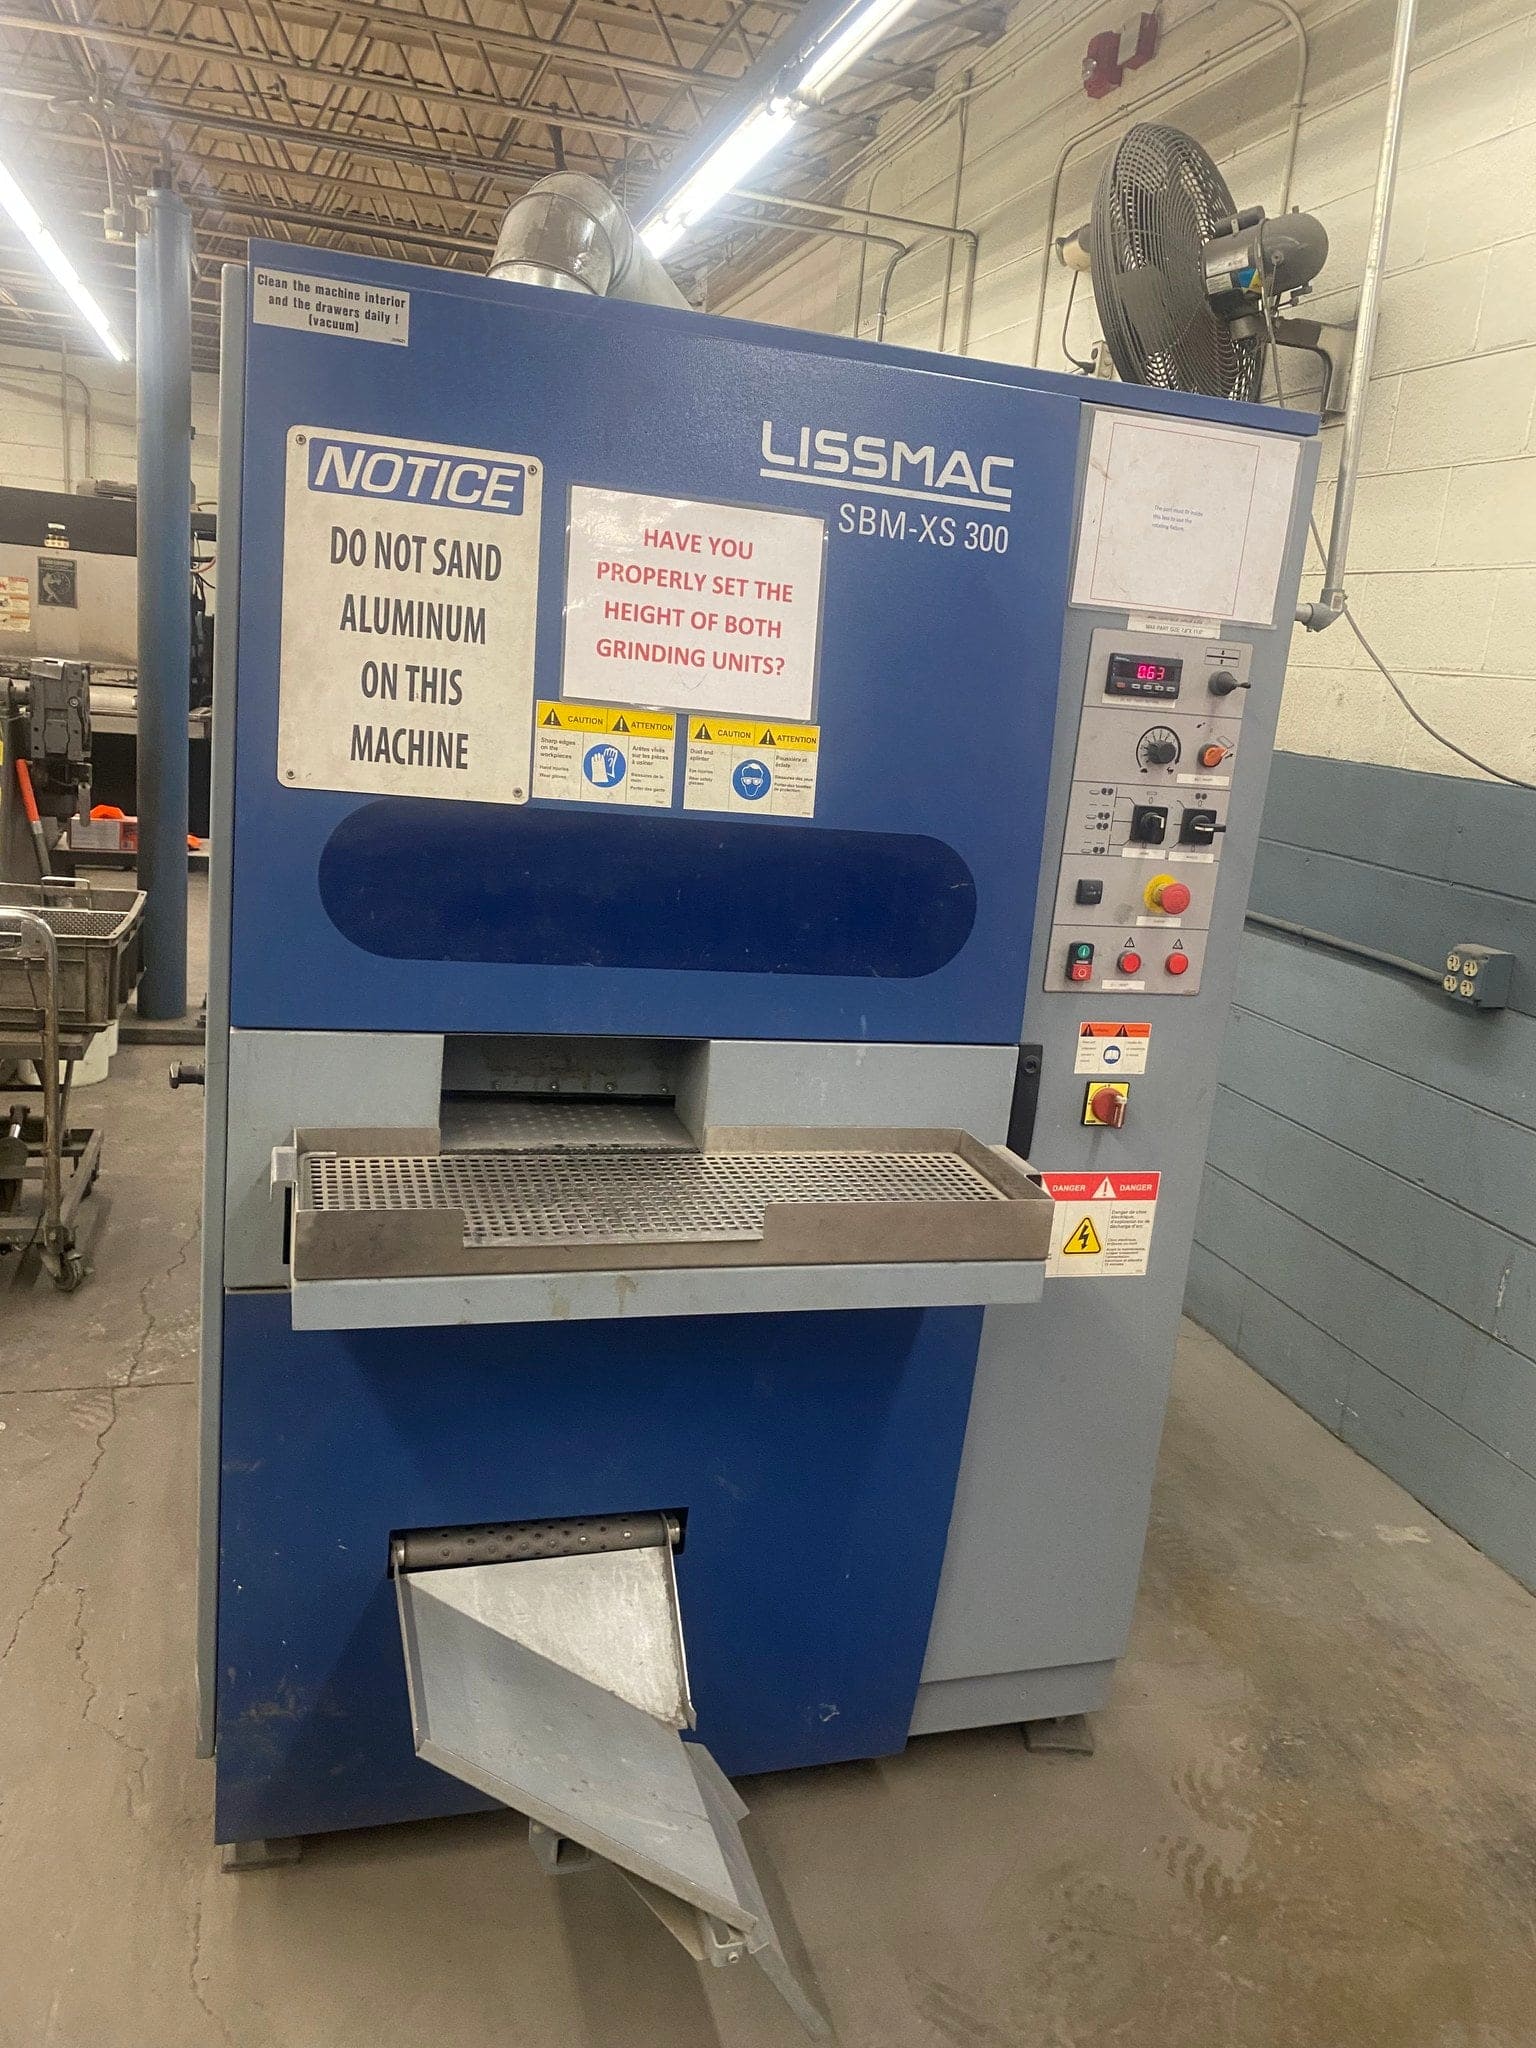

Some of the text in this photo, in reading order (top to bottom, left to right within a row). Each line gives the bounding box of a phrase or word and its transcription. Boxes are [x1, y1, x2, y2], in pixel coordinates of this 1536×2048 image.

[257, 274, 406, 308] Clean the machine interior
[268, 295, 288, 306] and
[294, 298, 310, 310] the
[315, 302, 360, 318] drawers
[364, 310, 390, 324] daily
[308, 314, 359, 333] (vacuum)
[314, 445, 520, 508] NOTICE
[762, 420, 1014, 498] LISSMAC
[644, 528, 754, 560] HAVE YOU
[838, 502, 1008, 554] SBM-XS 300
[330, 526, 502, 582] DO NOT SAND
[596, 561, 794, 603] PROPERLY SET THE
[340, 593, 486, 645] ALUMINUM
[604, 600, 782, 638] HEIGHT OF BOTH
[596, 638, 786, 676] GRINDING UNITS?
[361, 660, 463, 706] ON THIS
[568, 715, 603, 725] CAUTION
[631, 721, 672, 732] ATTENTION
[718, 730, 751, 738] CAUTION
[350, 724, 469, 770] MACHINE
[540, 736, 558, 744] Sharp
[777, 734, 816, 744] ATTENTION
[1052, 1184, 1086, 1192] DANGER
